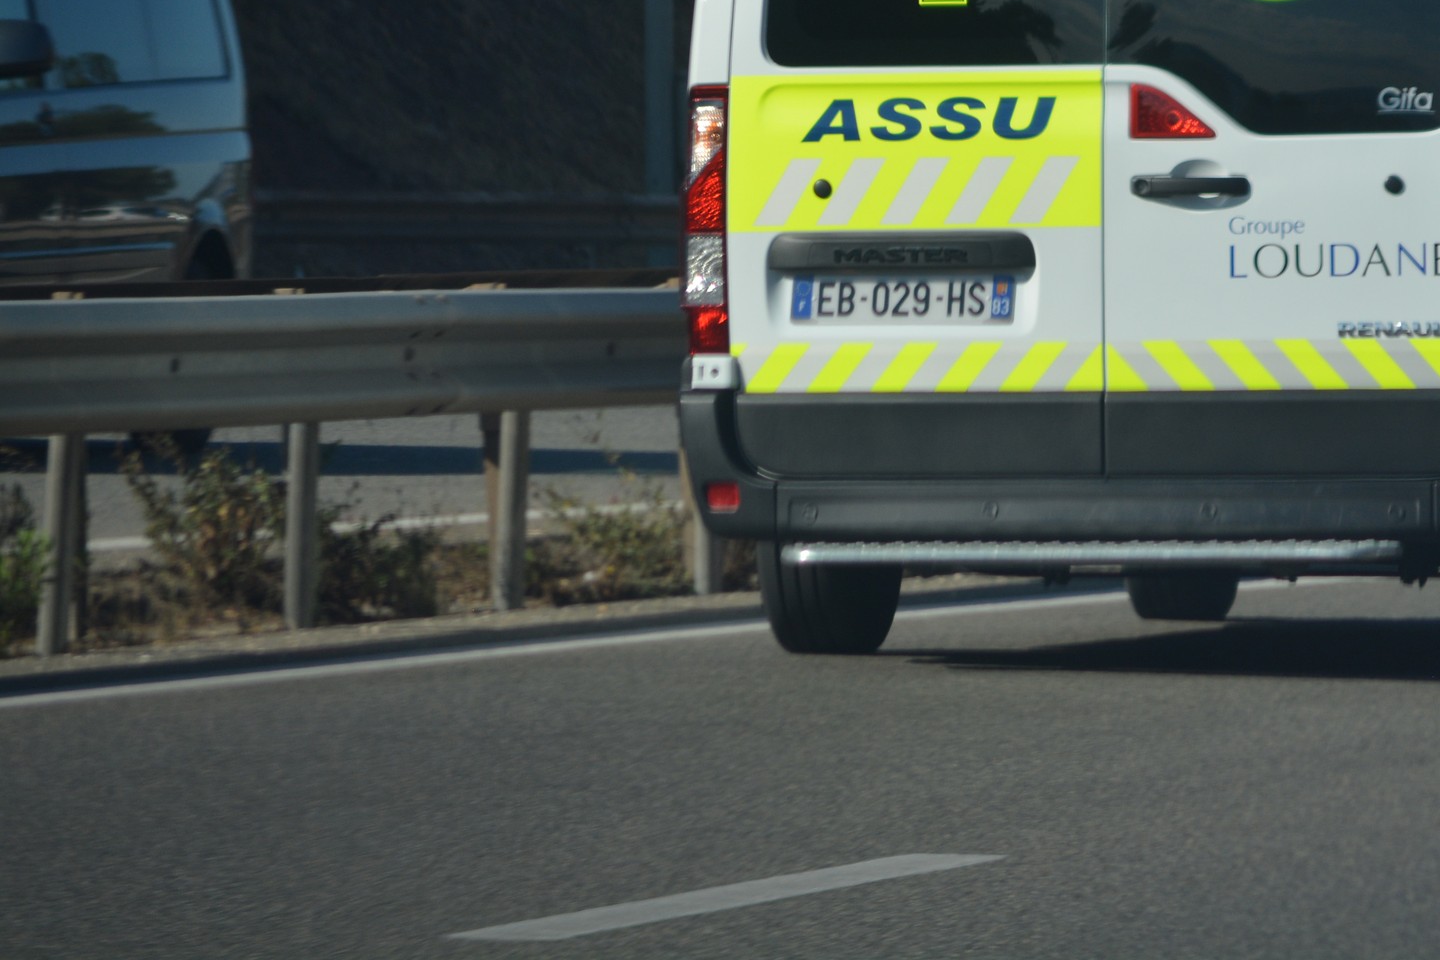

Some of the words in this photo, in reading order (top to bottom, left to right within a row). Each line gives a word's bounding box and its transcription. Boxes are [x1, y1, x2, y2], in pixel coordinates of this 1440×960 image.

[1377, 86, 1435, 111] Gifa
[801, 96, 1057, 143] ASSU
[1228, 216, 1306, 239] Groupe
[832, 246, 969, 265] MASTER
[816, 280, 988, 318] EB-029-HS
[991, 297, 1010, 316] 83
